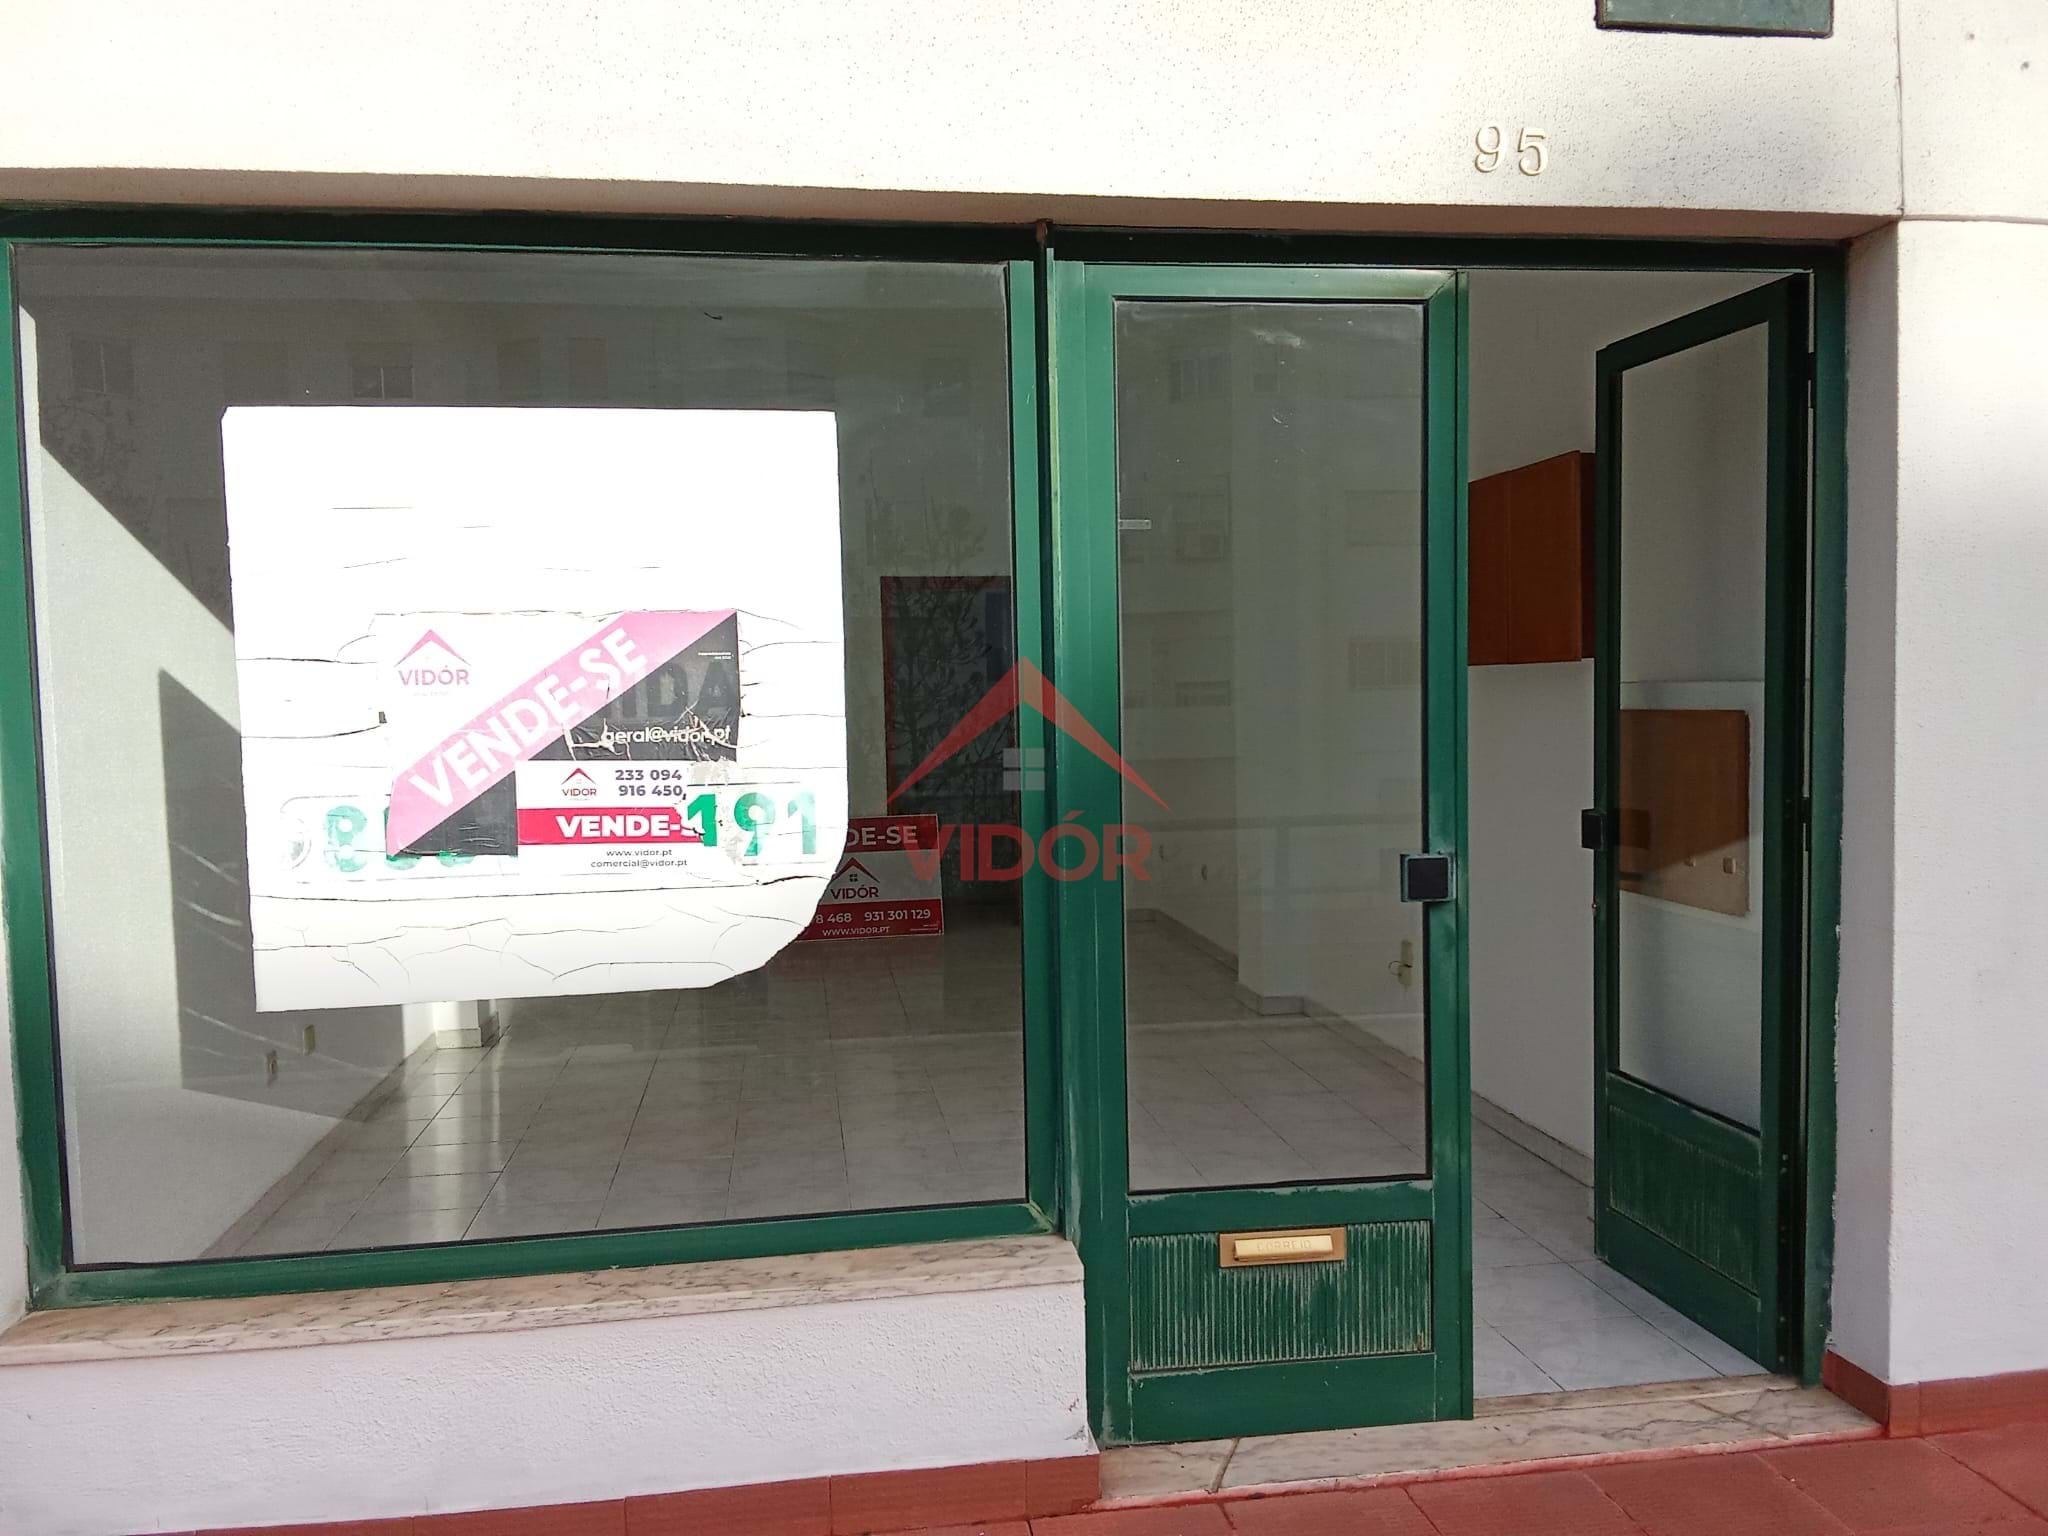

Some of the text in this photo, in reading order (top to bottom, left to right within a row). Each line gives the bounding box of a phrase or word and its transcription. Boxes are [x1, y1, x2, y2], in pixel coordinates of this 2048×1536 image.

[1474, 126, 1548, 176] 95
[397, 665, 470, 686] VIDÓR
[408, 627, 649, 809] VENDE-SE
[615, 769, 682, 781] 233 094
[618, 785, 683, 797] 916 450
[687, 792, 817, 857] 191
[606, 849, 672, 857] www.vidor.pt
[590, 859, 688, 869] comercial@vidor.pt
[830, 884, 880, 900] VIDÓR
[827, 913, 852, 924] 468
[864, 910, 885, 922] 931
[887, 909, 908, 921] 301
[911, 908, 931, 920] 129
[1257, 1239, 1312, 1253] CORREIO
